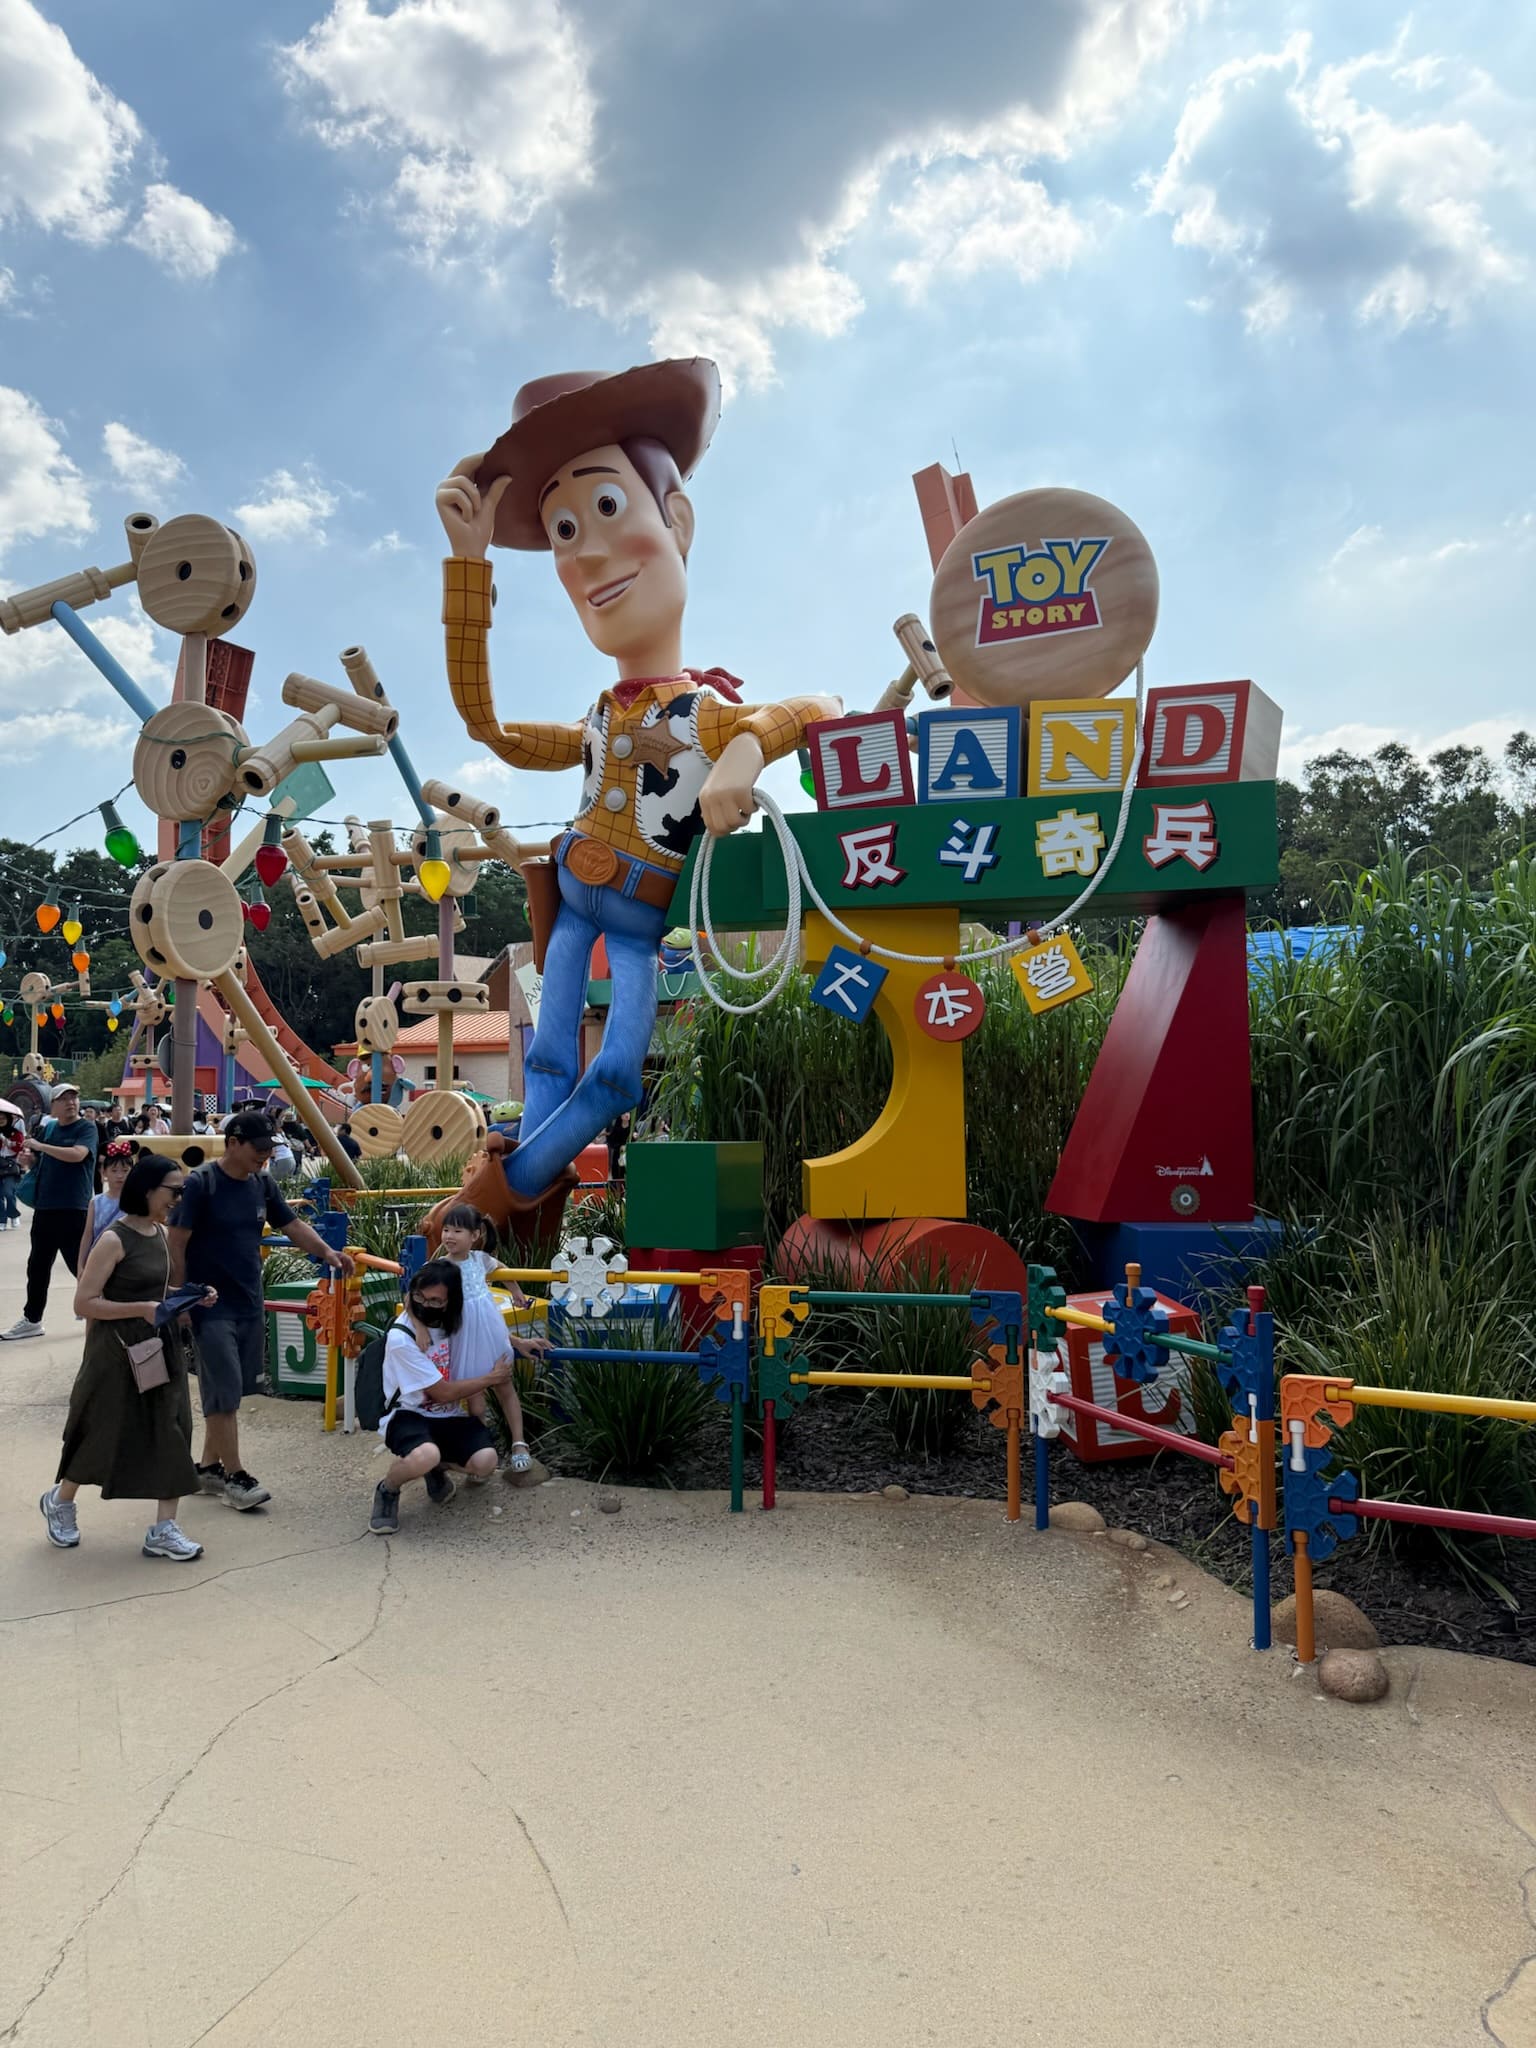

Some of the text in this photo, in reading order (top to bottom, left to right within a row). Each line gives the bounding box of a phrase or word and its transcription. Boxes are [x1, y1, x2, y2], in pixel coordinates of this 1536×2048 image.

[974, 539, 1110, 607] TOY
[991, 602, 1087, 629] STORY
[829, 703, 1227, 796] LAND
[840, 800, 1220, 888] 反斗奇兵
